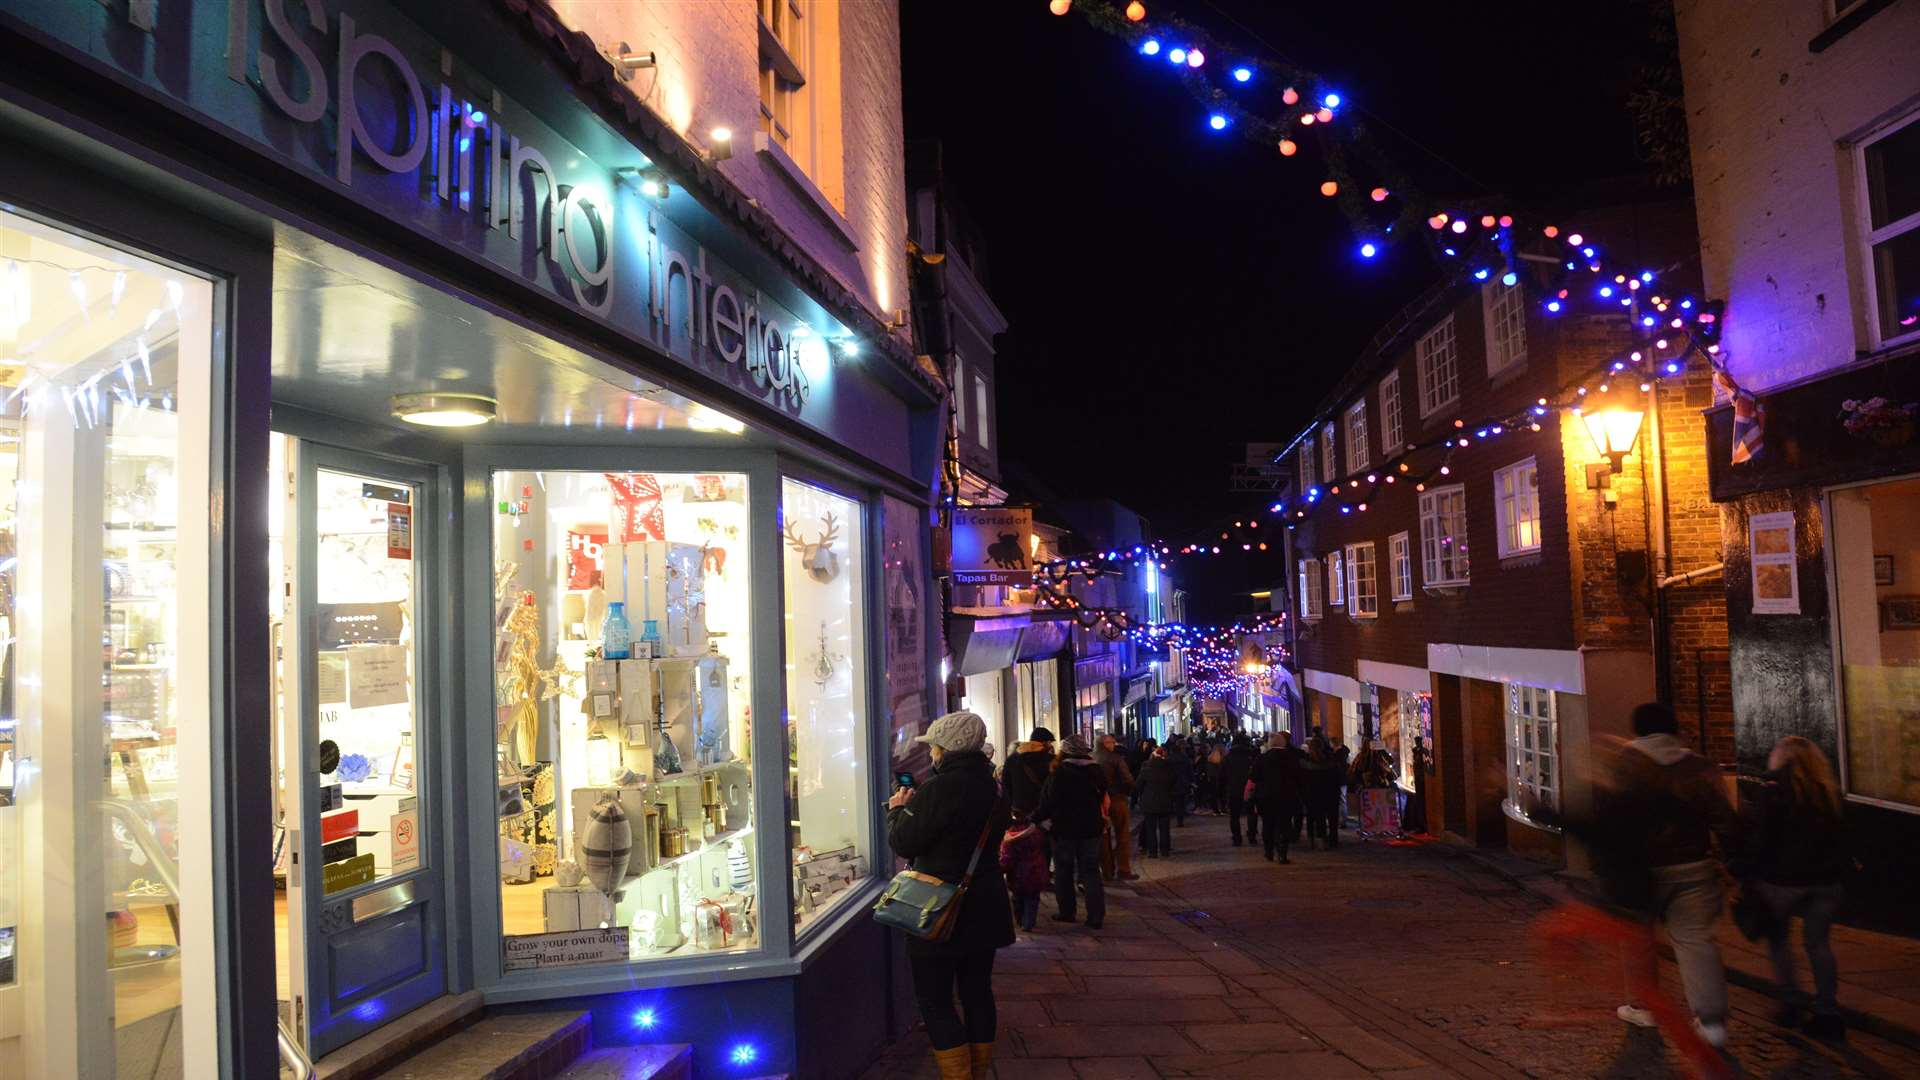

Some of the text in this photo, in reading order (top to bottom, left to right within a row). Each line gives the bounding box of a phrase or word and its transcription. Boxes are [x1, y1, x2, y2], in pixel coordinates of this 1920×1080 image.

[955, 515, 1028, 526] El Cortador
[956, 573, 1008, 583] Tapas Bar
[507, 940, 538, 952] Grow
[542, 938, 568, 951] your
[571, 936, 595, 945] own
[536, 952, 565, 965] Plant
